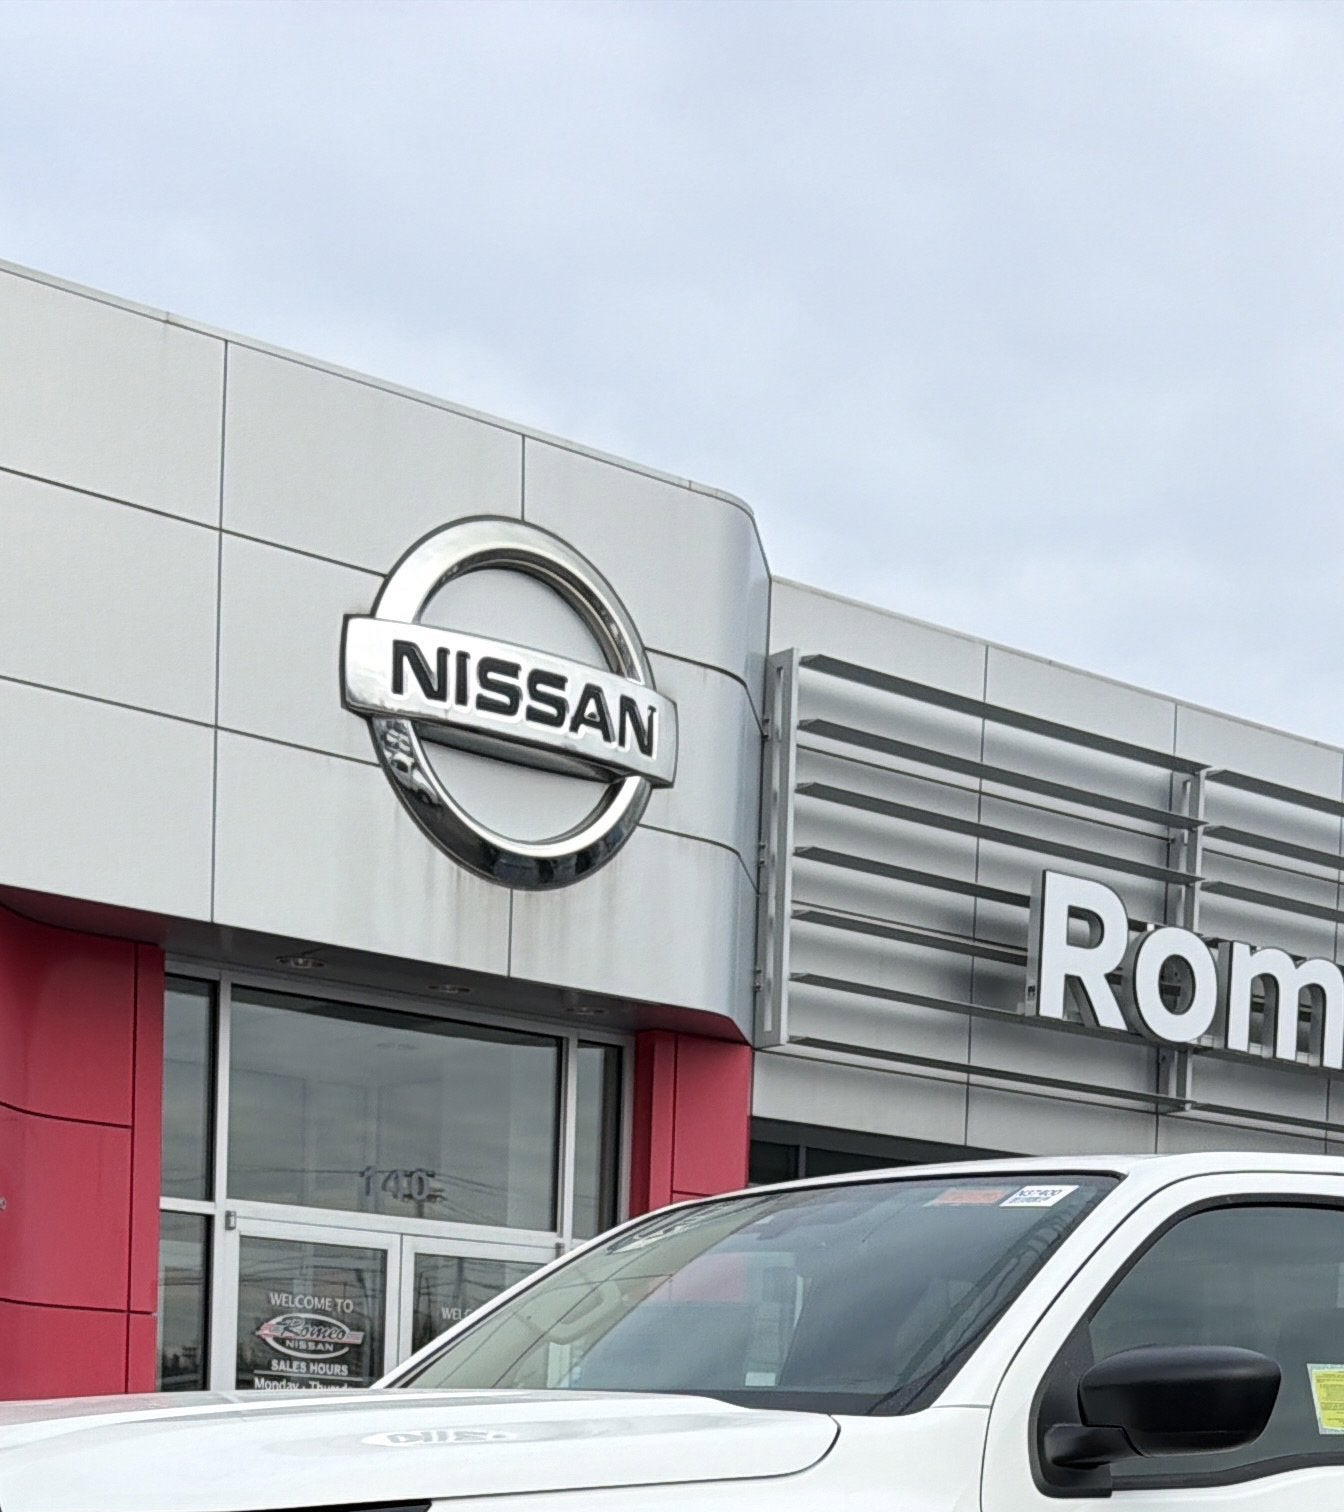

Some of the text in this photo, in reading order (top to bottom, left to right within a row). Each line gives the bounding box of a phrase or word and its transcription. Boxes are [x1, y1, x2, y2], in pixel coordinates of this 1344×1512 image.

[391, 639, 657, 759] NISSAN
[360, 1166, 430, 1201] 140
[269, 1292, 354, 1313] WELCOME TO
[281, 1316, 346, 1341] Romeo
[285, 1340, 334, 1352] NISSAN
[271, 1359, 349, 1376] SALES HOURS
